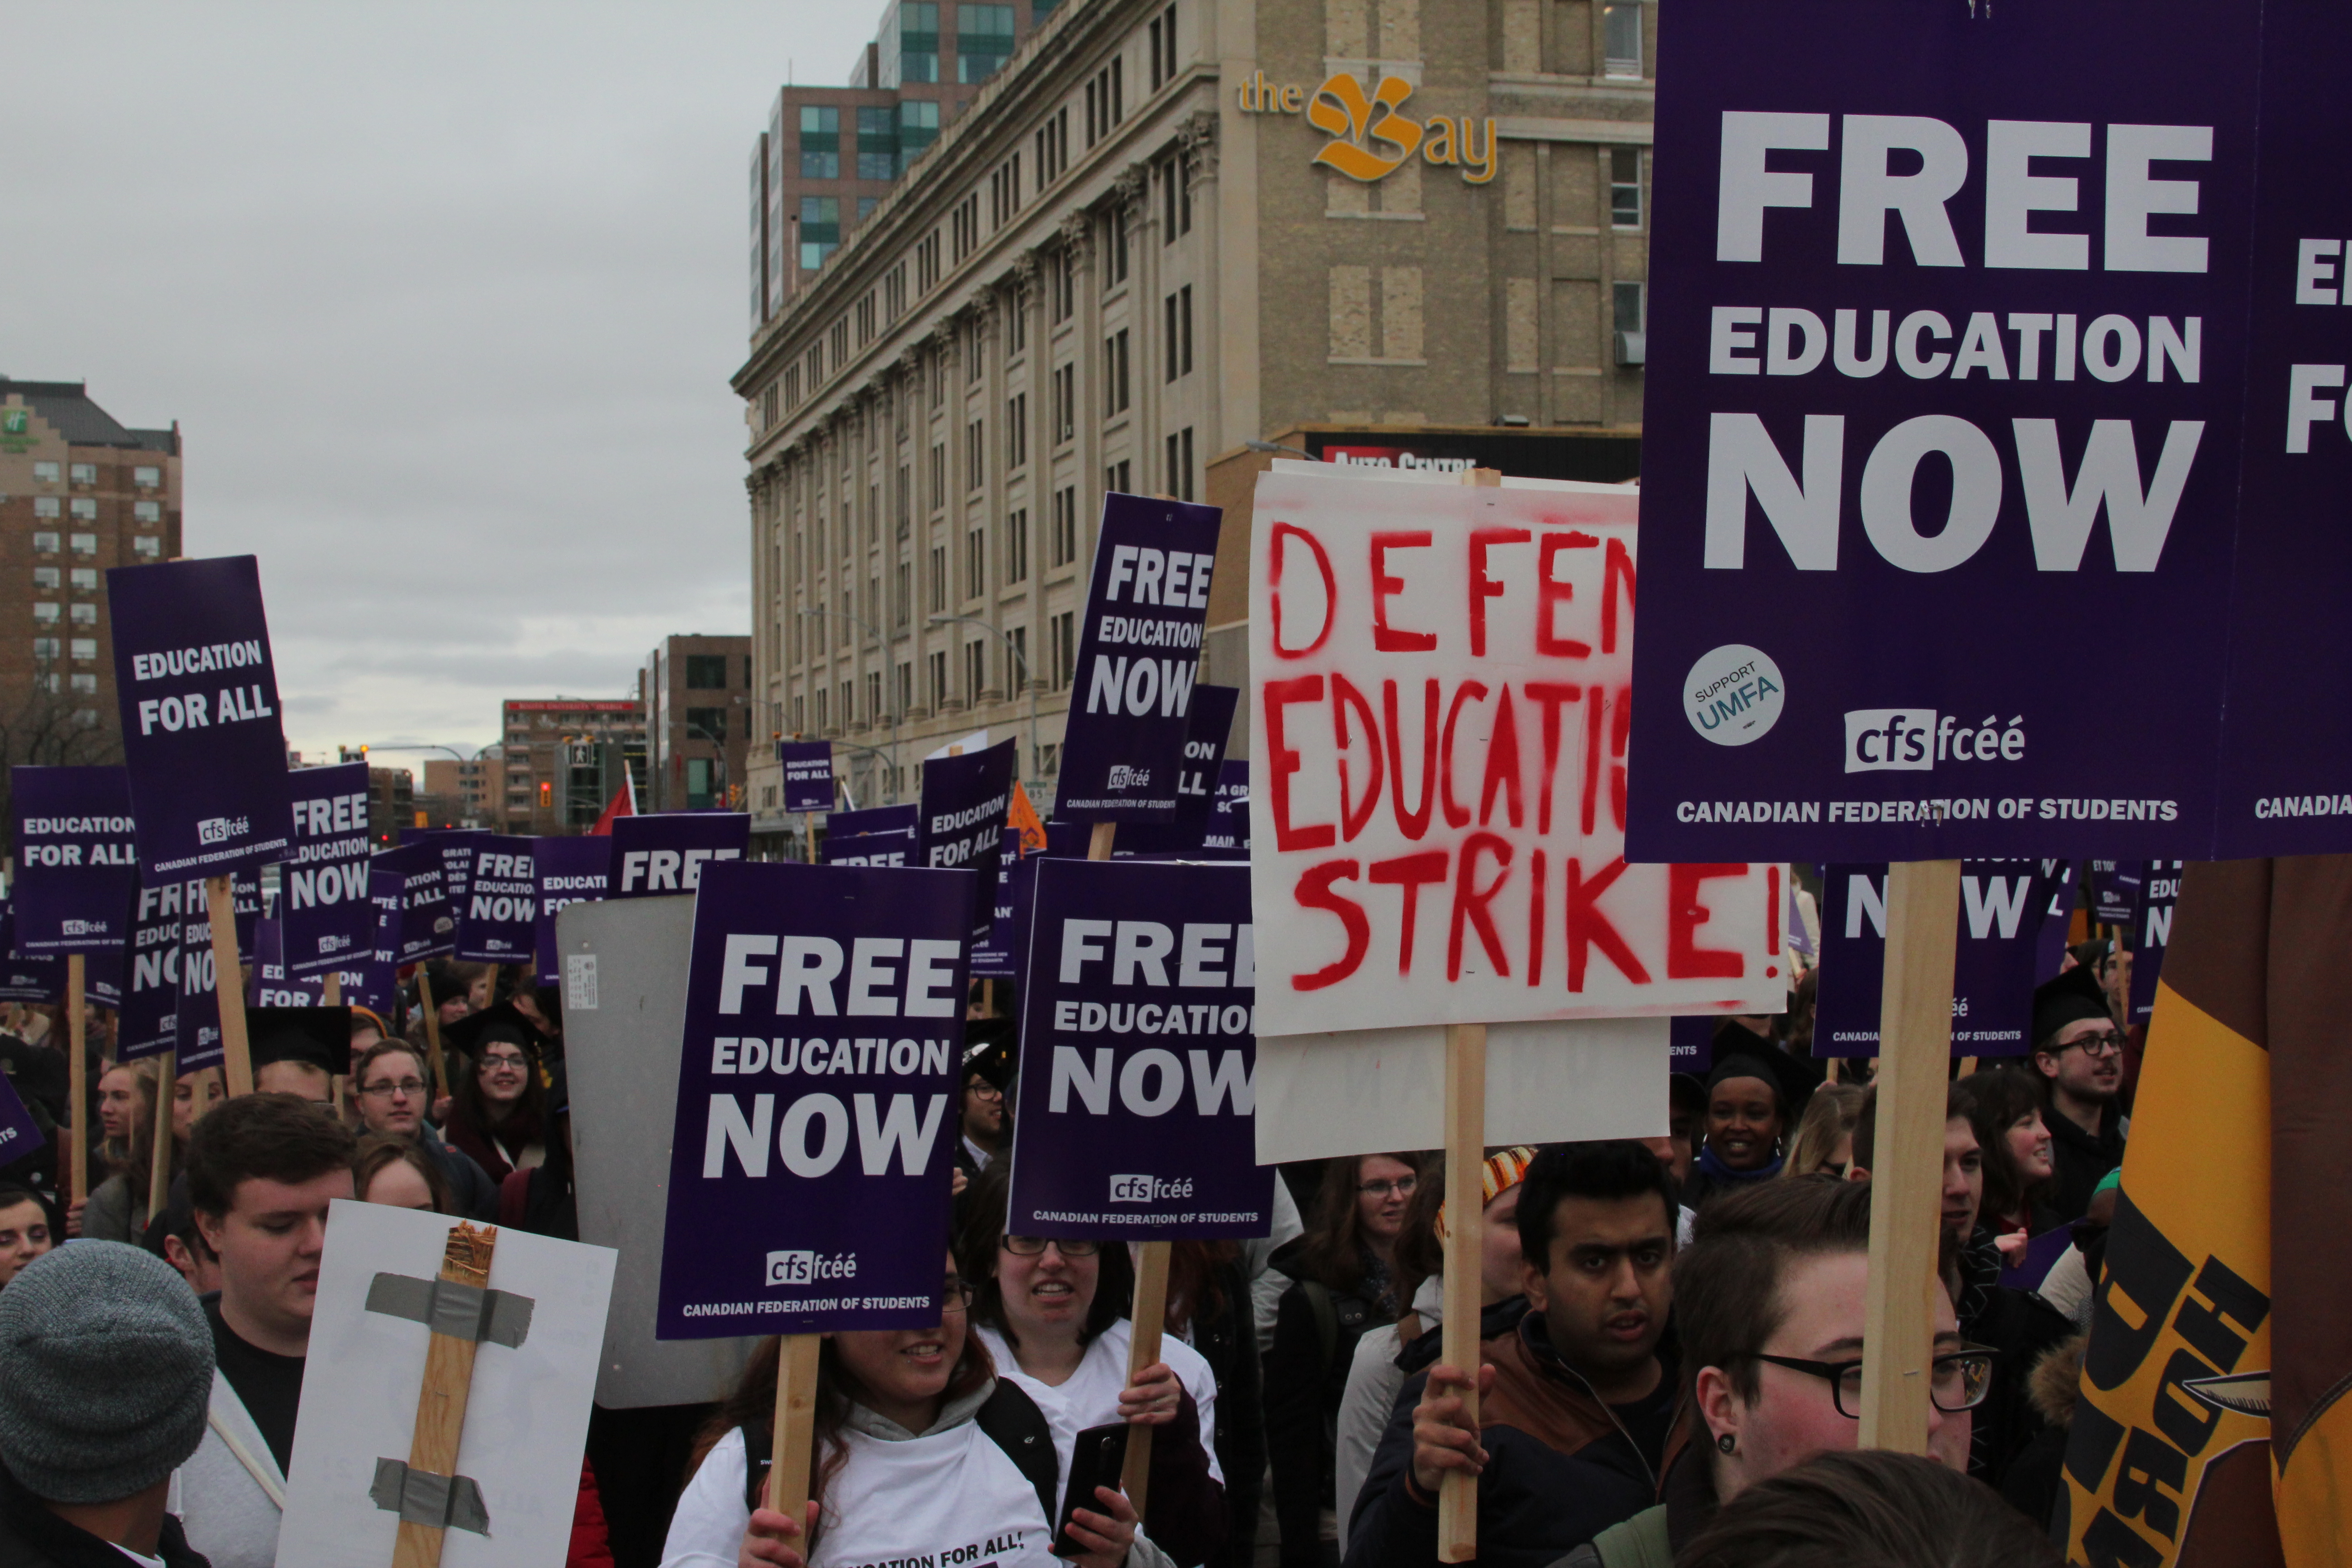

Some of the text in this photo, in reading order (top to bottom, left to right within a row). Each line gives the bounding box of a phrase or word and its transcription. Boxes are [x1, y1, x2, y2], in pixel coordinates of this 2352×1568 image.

[1240, 69, 1498, 184] the Bay
[1717, 111, 2213, 273] FREE
[1710, 307, 2201, 382] EDUCATION
[1704, 413, 2205, 573] NOW
[1107, 545, 1213, 608] FREE
[1269, 521, 1636, 659] DEFEN
[1098, 616, 1202, 649] EDUCATION
[133, 640, 261, 680] EDUCATION
[1087, 655, 1198, 717] NOW
[1695, 661, 1779, 730] SUPPORT UMFA
[139, 685, 271, 735] FOR ALL
[787, 760, 829, 769] EDUCATION
[788, 770, 829, 780] FOR ALL
[1263, 671, 1632, 852] EDUCATI
[293, 793, 367, 835] FREE
[931, 794, 1005, 834] EDUCATION
[1067, 799, 1101, 808] CANADIAN
[1101, 799, 1137, 808] FEDERATION
[1147, 800, 1176, 808] STUDENTS
[1677, 799, 2177, 822] CANADIAN FEDERATION OF STUDENTS
[2255, 795, 2352, 818] CANADIA
[24, 817, 135, 834] EDUCATION
[25, 844, 137, 866] FOR ALL
[155, 838, 288, 872] CANADIAN FEDERATION OF STUDENTS
[929, 824, 1000, 868] FOR ALL
[290, 861, 369, 910] NOW
[404, 869, 441, 888] ATION
[474, 880, 534, 895] EDUCATIO
[543, 875, 607, 890] EDUCATI
[621, 849, 740, 892] FRE
[413, 887, 446, 907] ALL
[470, 896, 535, 922] NOW
[1291, 833, 1781, 993] STRIKE!
[719, 934, 960, 1017] FREE
[259, 988, 311, 1007] FOR
[1054, 999, 1255, 1037] EDUCATIO
[1833, 1031, 1879, 1042] CANADIA
[1956, 1030, 2022, 1042] OF STUDENTS
[711, 1038, 950, 1075] EDUCATION
[1049, 1046, 1255, 1117] NOW
[703, 1093, 948, 1178] NOW
[1034, 1210, 1258, 1224] CANADIAN FEDERATION OF STUDENTS
[683, 1297, 929, 1316] CANADIAN FEDERATION OF STUDENTS
[941, 1544, 979, 1568] FOR
